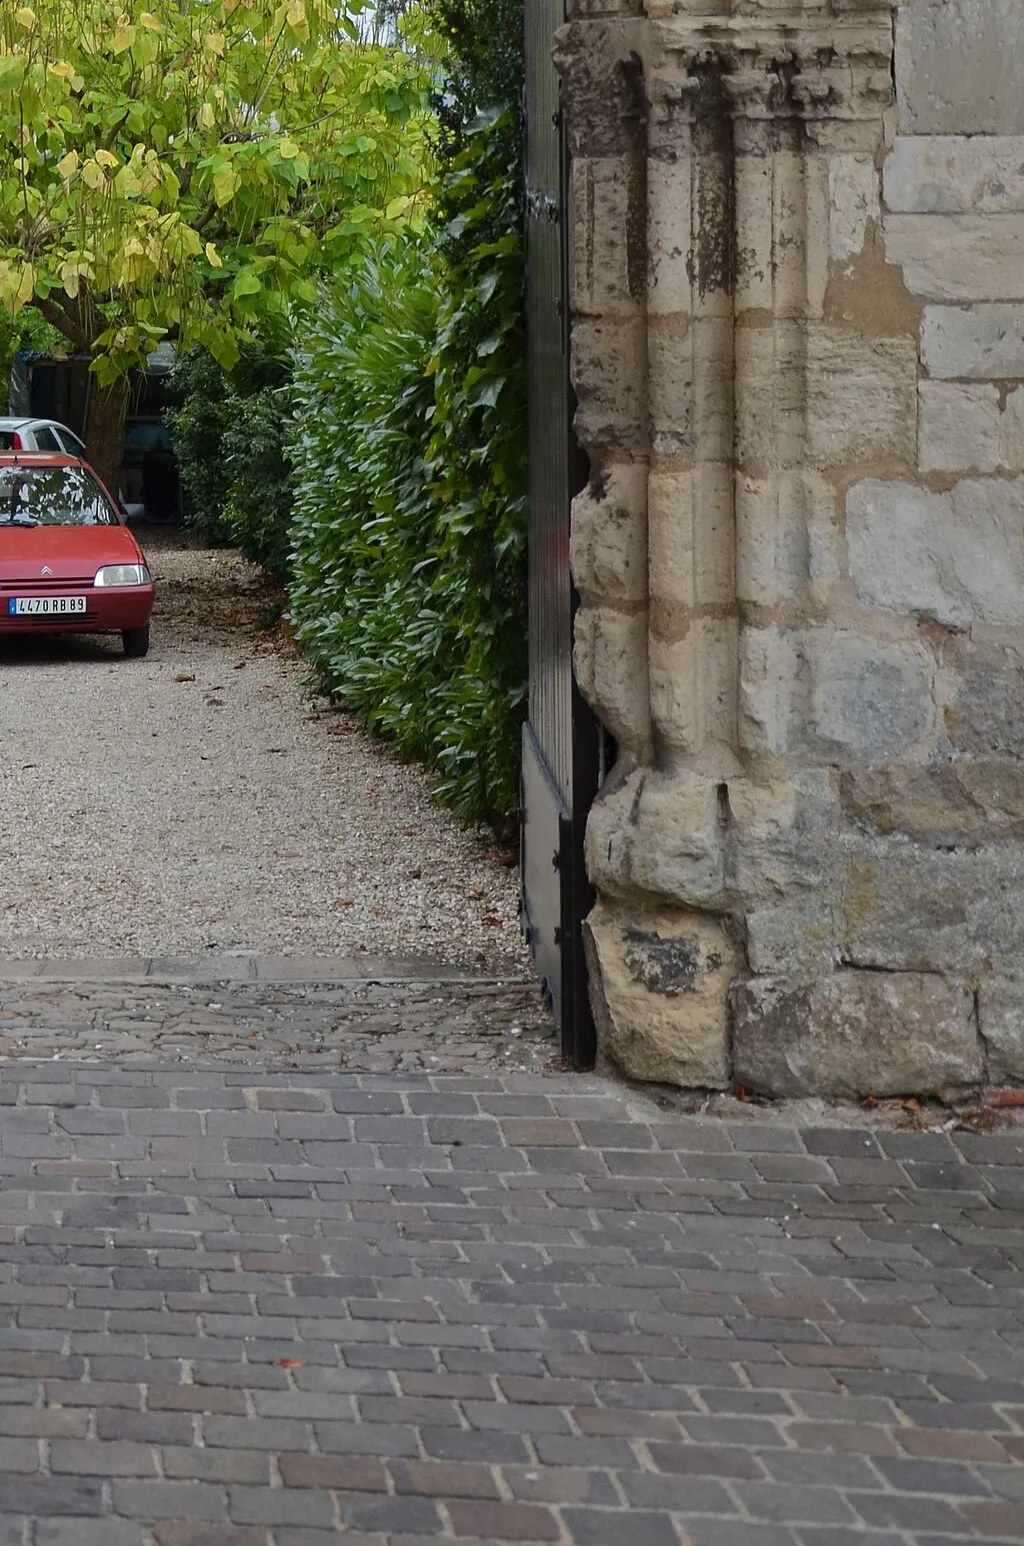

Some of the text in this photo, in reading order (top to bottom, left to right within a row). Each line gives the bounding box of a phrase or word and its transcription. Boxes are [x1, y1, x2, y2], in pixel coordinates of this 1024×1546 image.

[19, 598, 84, 613] 4470 RB 89
